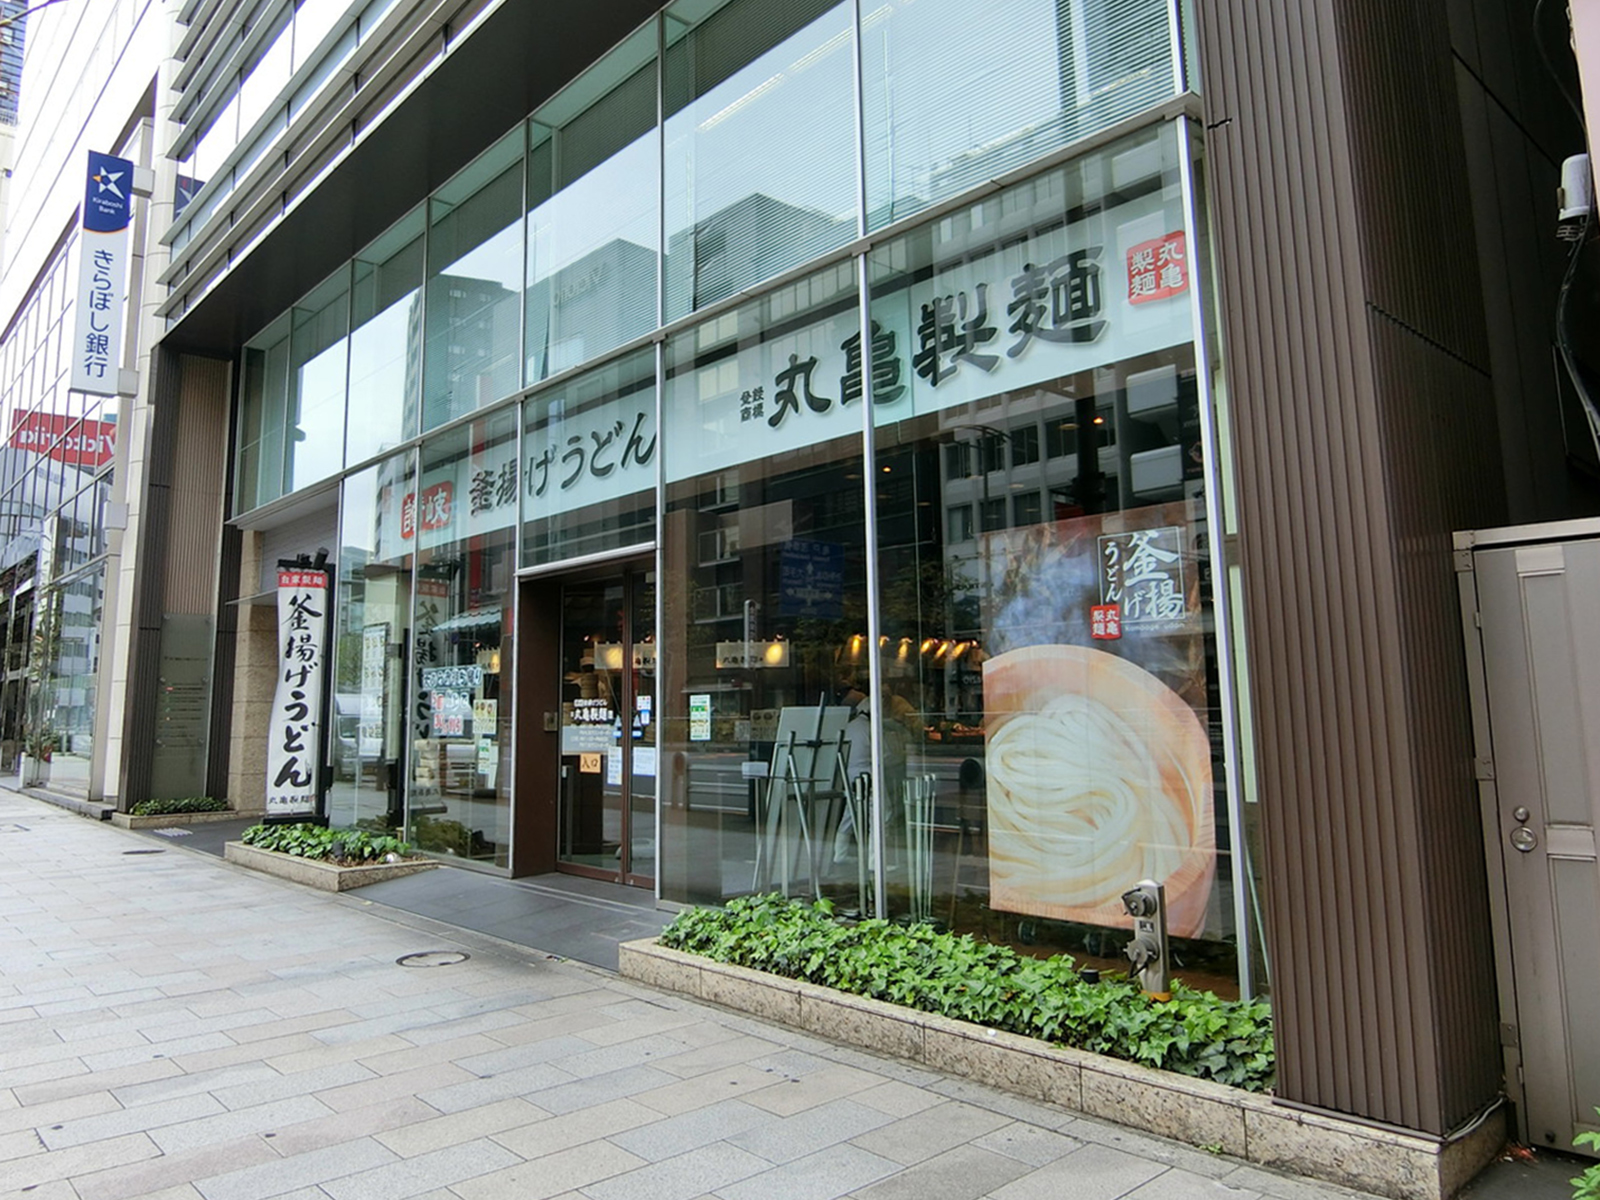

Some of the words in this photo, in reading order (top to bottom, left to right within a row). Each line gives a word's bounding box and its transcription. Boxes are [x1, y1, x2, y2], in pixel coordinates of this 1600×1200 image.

[99, 205, 115, 215] Bank
[1130, 248, 1157, 300] 製麺
[1157, 241, 1185, 289] 丸亀
[84, 249, 114, 378] きらぼし銀行
[767, 245, 1107, 428] 丸亀製麺
[469, 412, 657, 517] 釜揚げうどん
[1104, 541, 1122, 603] うどん
[273, 593, 323, 787] 釜揚げうどん
[582, 757, 599, 769] 入口
